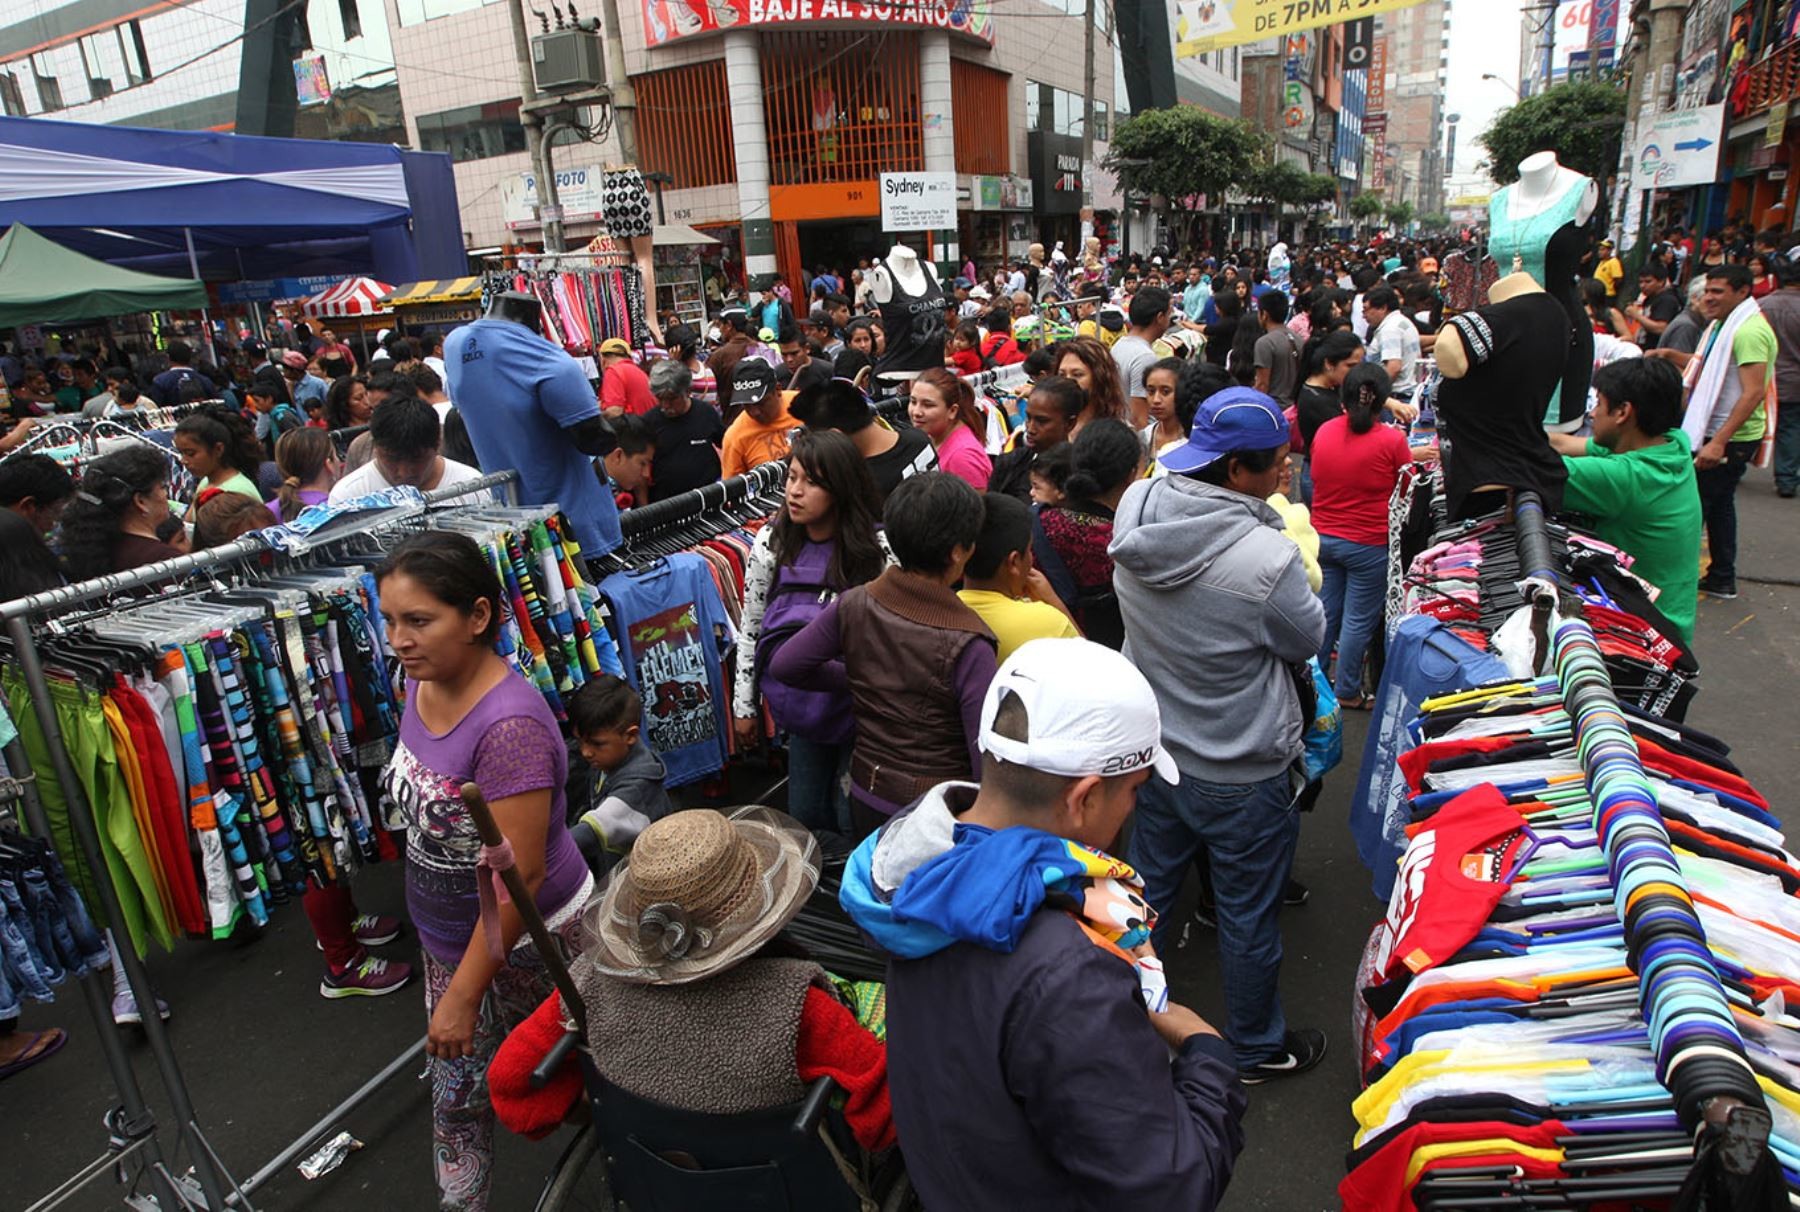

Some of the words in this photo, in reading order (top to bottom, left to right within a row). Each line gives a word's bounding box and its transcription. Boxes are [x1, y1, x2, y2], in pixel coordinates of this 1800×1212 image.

[750, 0, 813, 23] BAJE
[820, 0, 852, 19] AL
[1255, 12, 1277, 32] DE
[1282, 0, 1331, 25] 7PM
[1057, 154, 1080, 171] PARADA
[847, 191, 863, 200] 901
[886, 177, 925, 197] Sydney
[733, 379, 761, 390] didas
